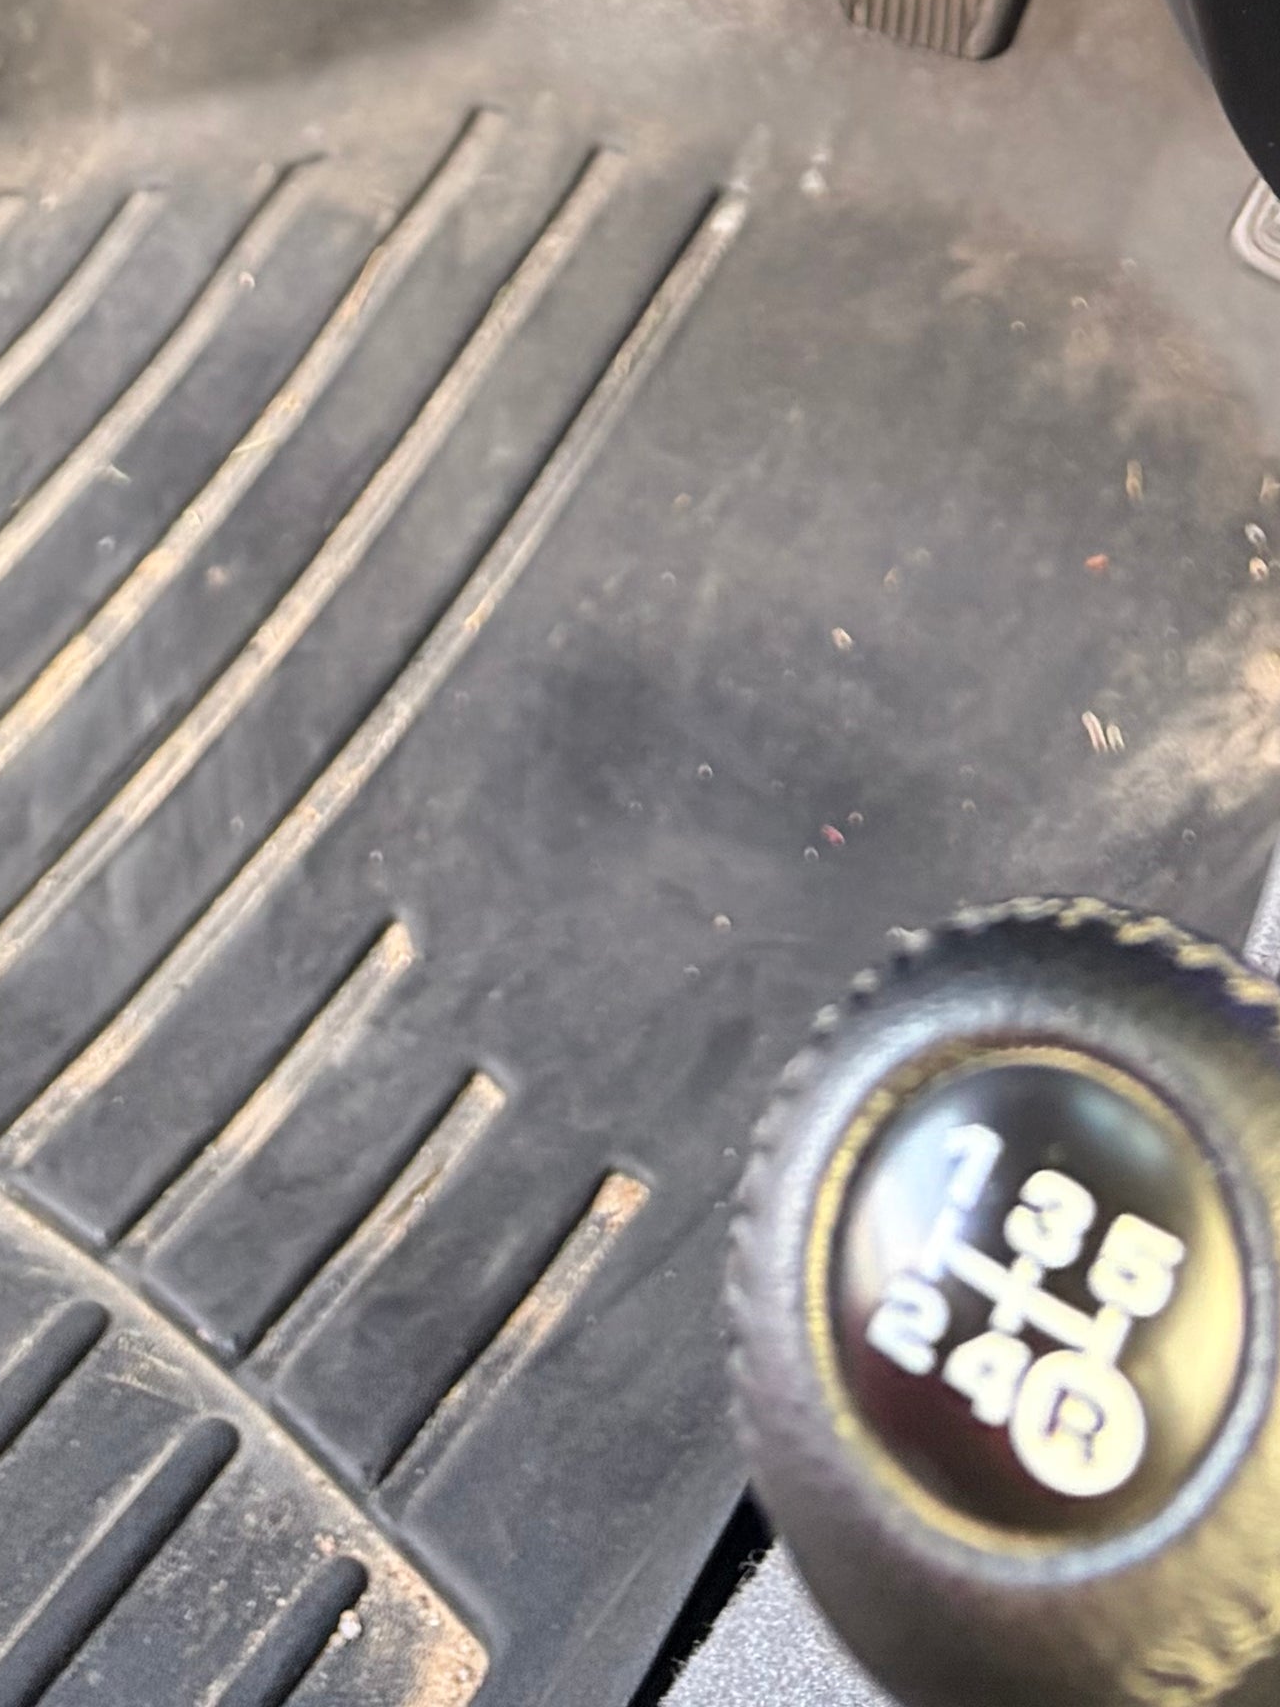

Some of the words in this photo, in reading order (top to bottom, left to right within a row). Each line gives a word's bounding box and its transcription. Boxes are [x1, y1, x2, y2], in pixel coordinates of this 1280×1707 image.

[943, 1122, 1004, 1211] 1
[1004, 1169, 1097, 1269] 3
[1088, 1213, 1186, 1318] 5
[866, 1277, 950, 1376] 2
[942, 1331, 1033, 1427] 4
